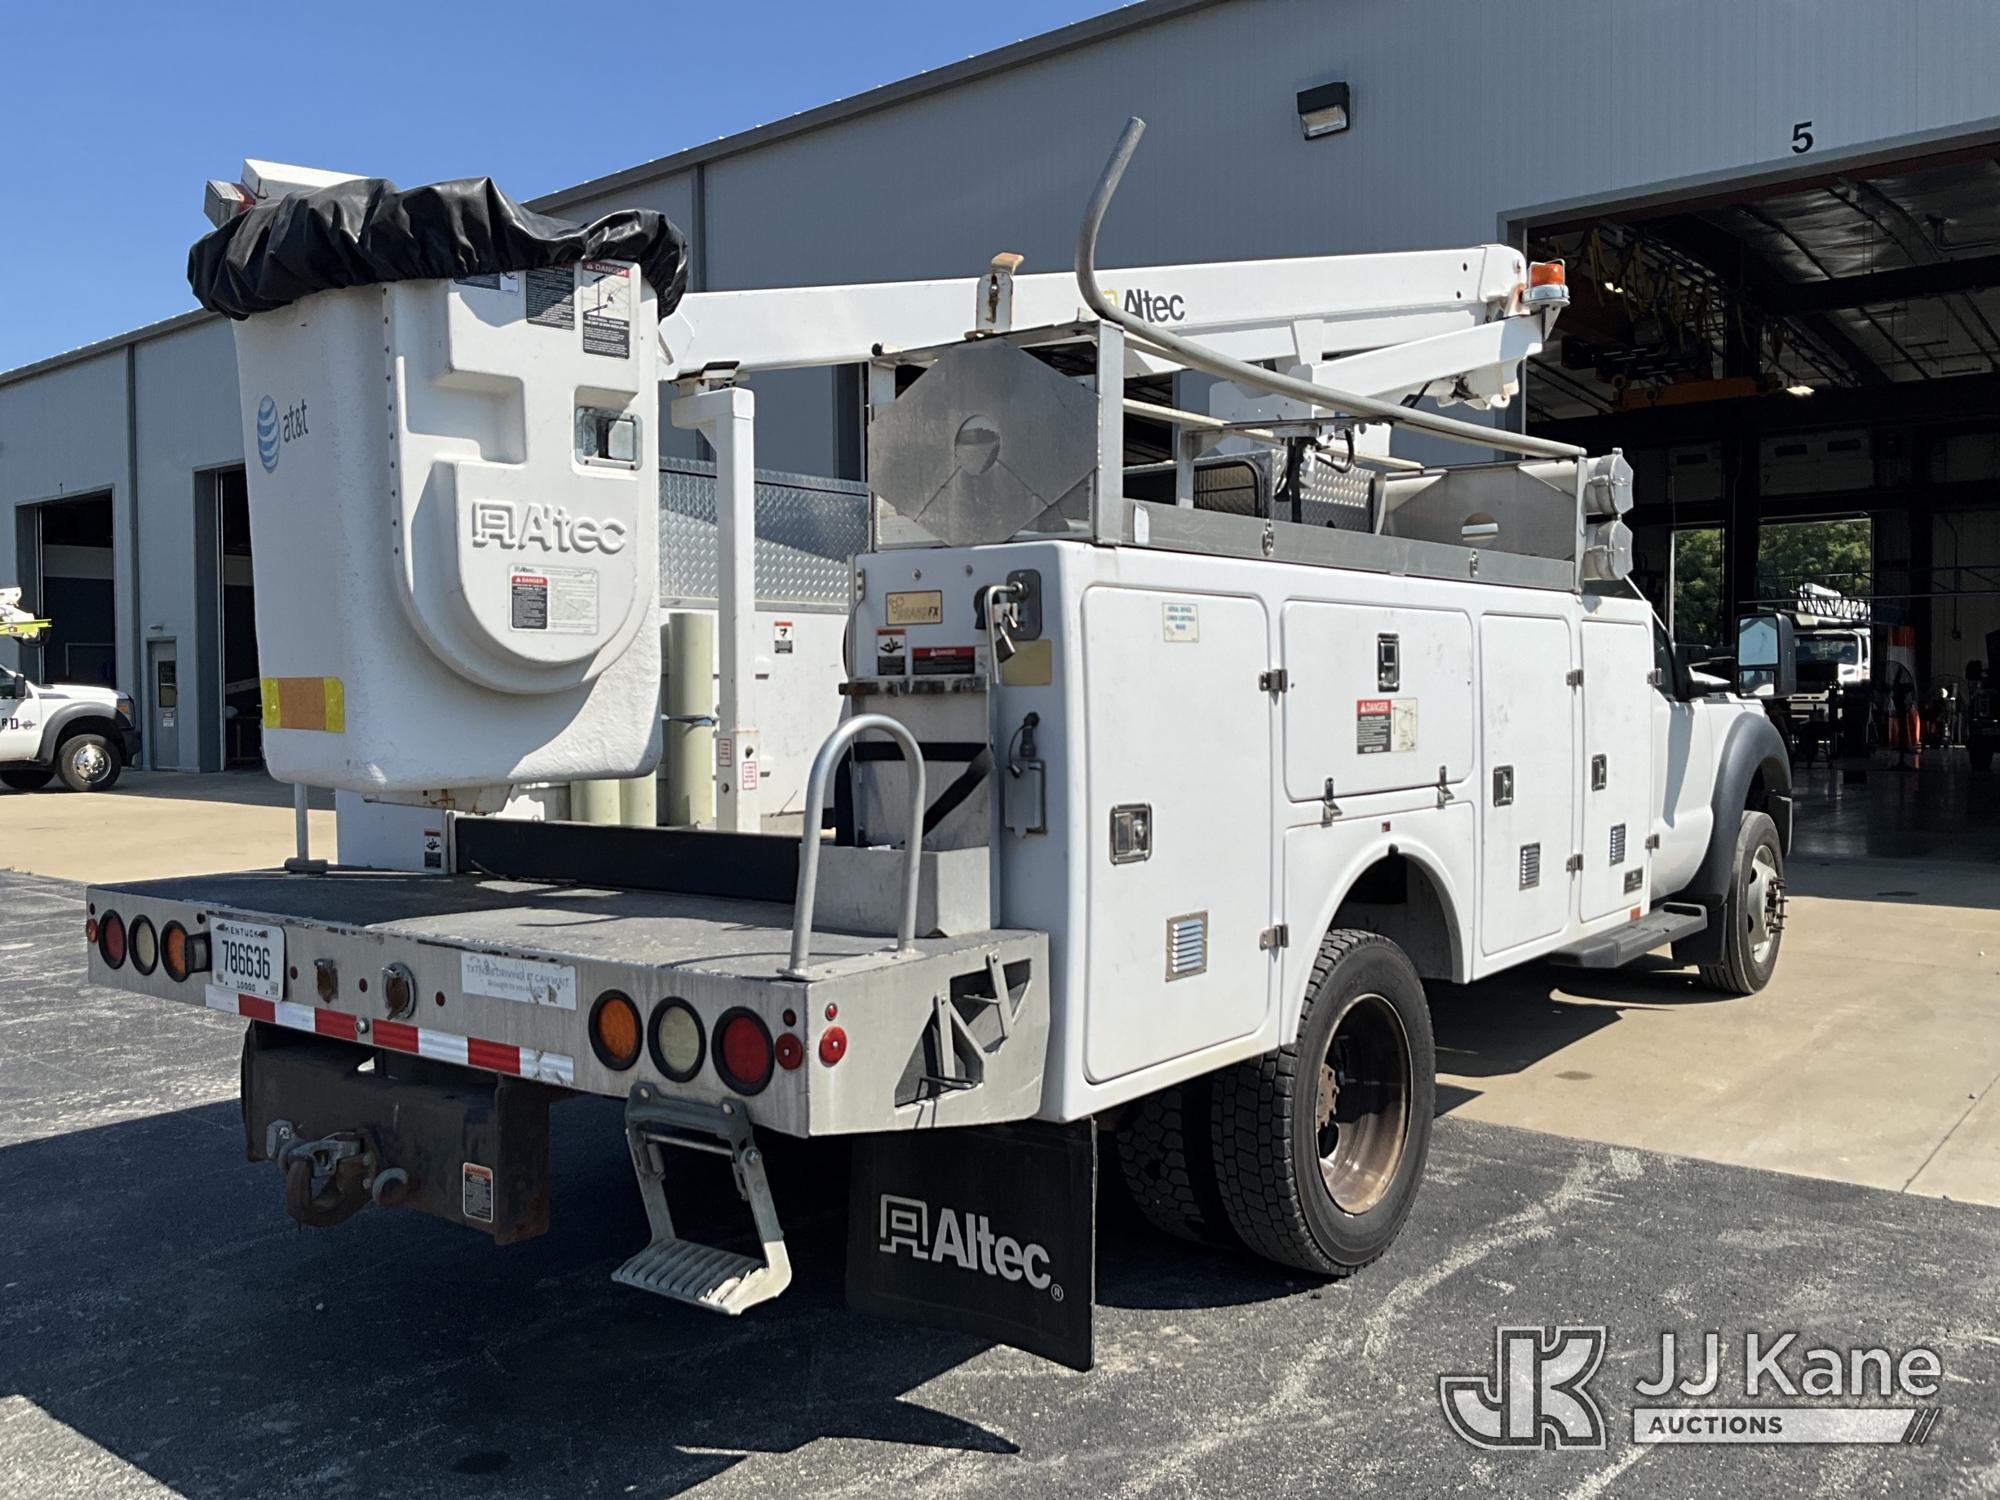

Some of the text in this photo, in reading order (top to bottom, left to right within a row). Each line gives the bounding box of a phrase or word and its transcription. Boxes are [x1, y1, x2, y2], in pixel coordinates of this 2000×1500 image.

[1792, 121, 1814, 154] 5
[1123, 289, 1186, 322] Altec
[283, 398, 309, 443] at&t
[517, 503, 627, 556] Altec
[1366, 701, 1389, 712] DANGER
[222, 940, 270, 980] 786636
[931, 1207, 1052, 1290] Altec
